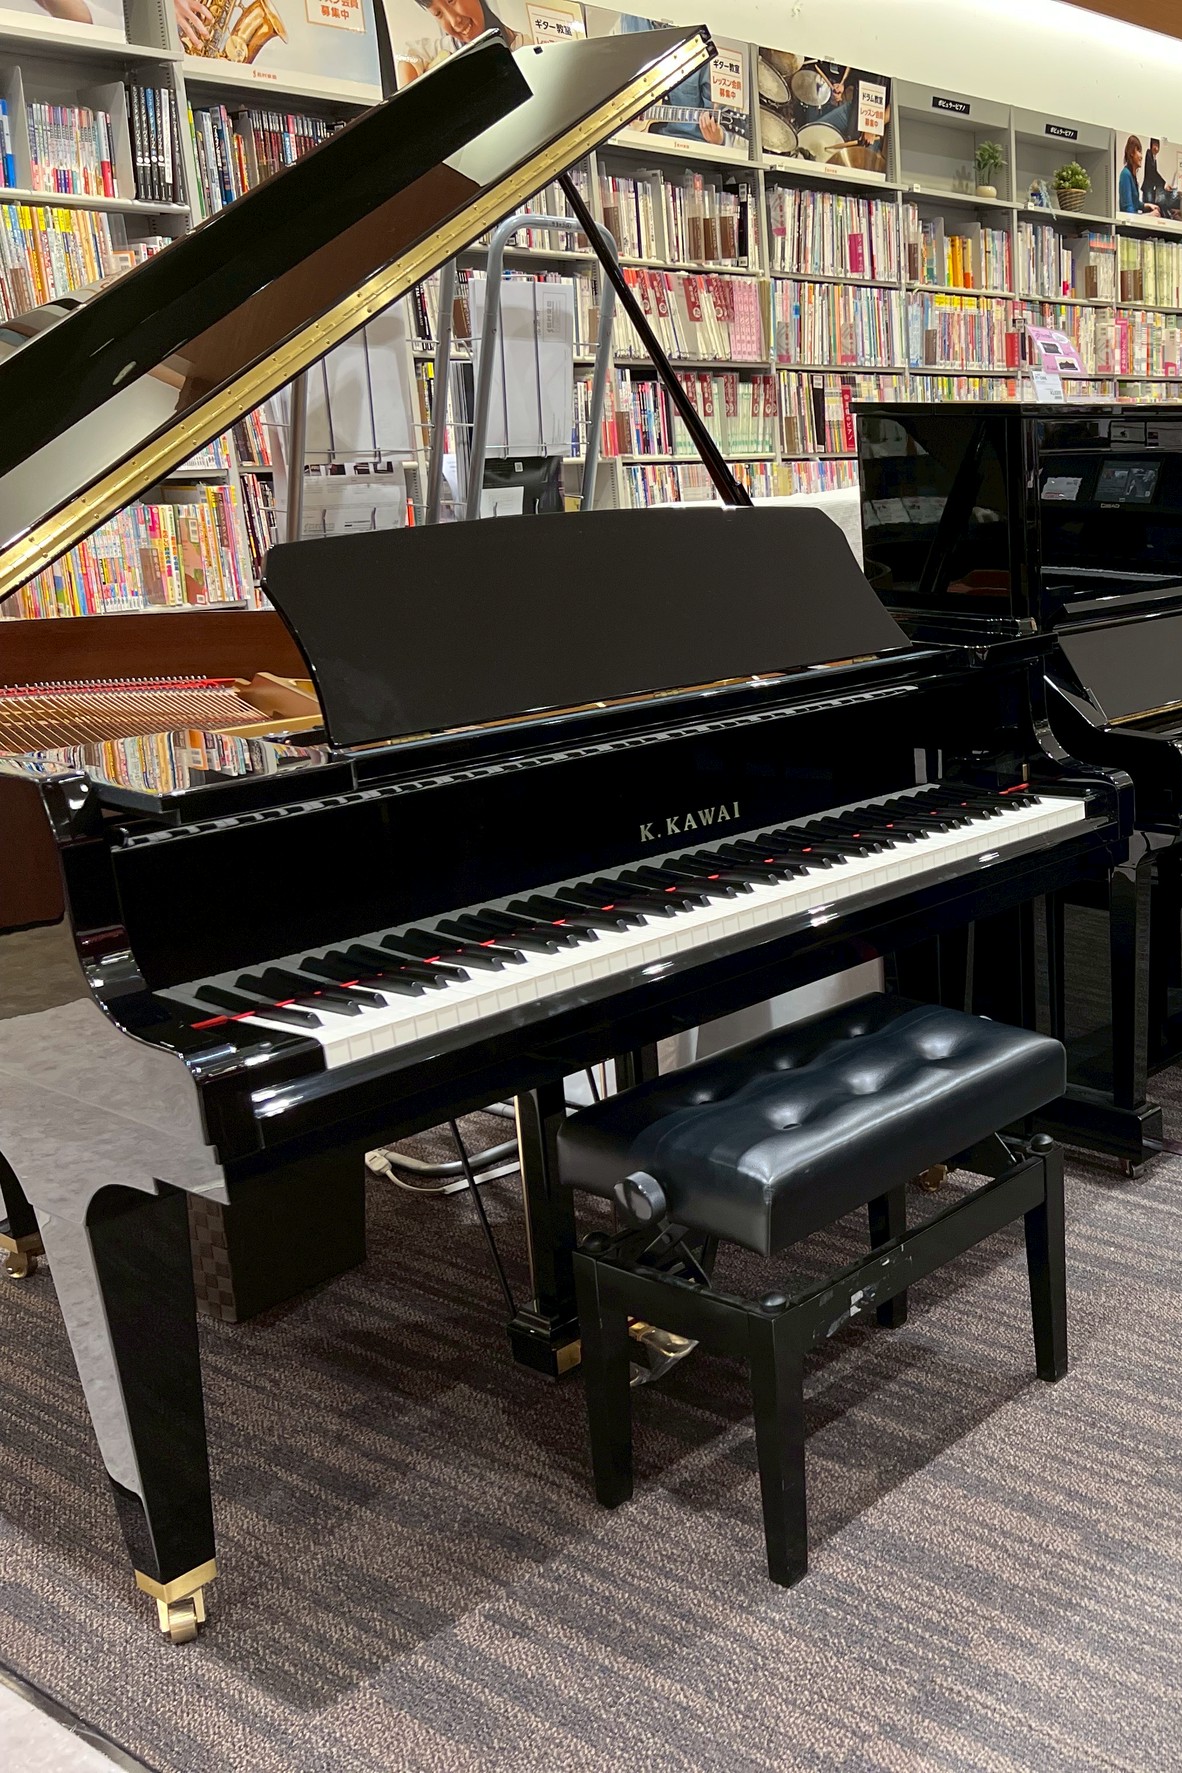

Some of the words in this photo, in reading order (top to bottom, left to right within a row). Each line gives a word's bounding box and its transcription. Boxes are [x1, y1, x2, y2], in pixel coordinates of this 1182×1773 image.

[320, 4, 350, 20] 募集中
[713, 59, 741, 75] ギター教室
[712, 76, 742, 91] レッスン会員
